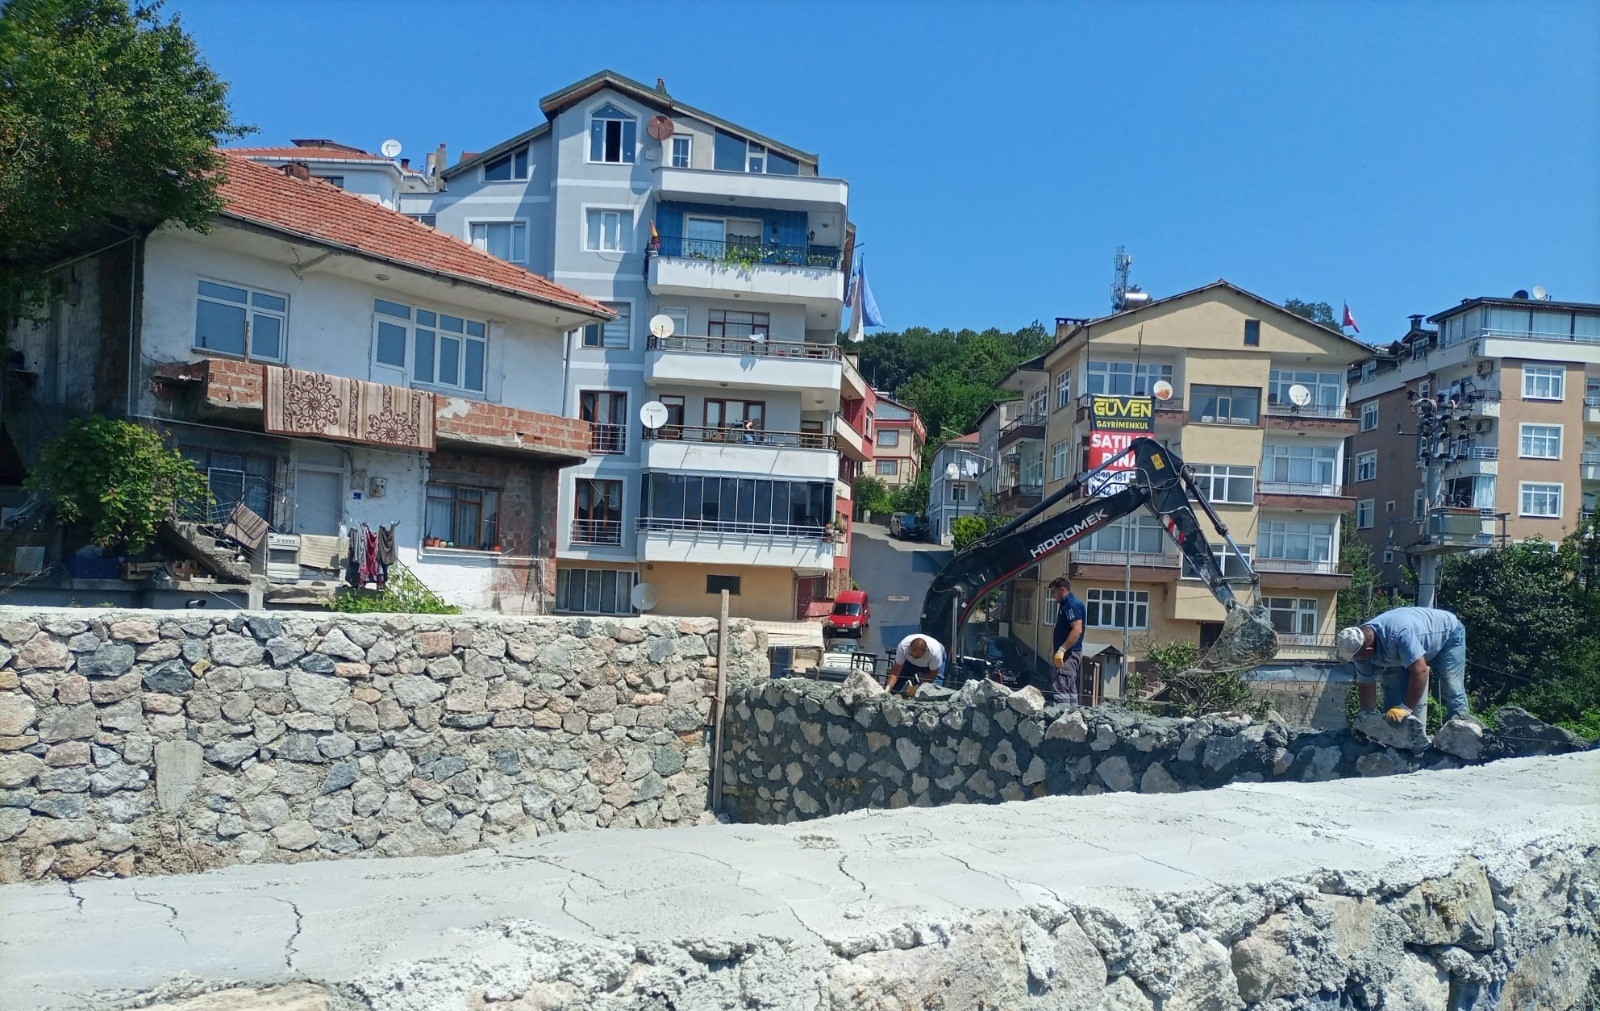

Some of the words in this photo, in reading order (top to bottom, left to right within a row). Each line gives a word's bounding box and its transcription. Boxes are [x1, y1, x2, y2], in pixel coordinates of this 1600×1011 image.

[1093, 397, 1152, 418] GÜVEN
[1096, 420, 1149, 430] GAYRİMENKUL
[1091, 433, 1152, 449] SATIL
